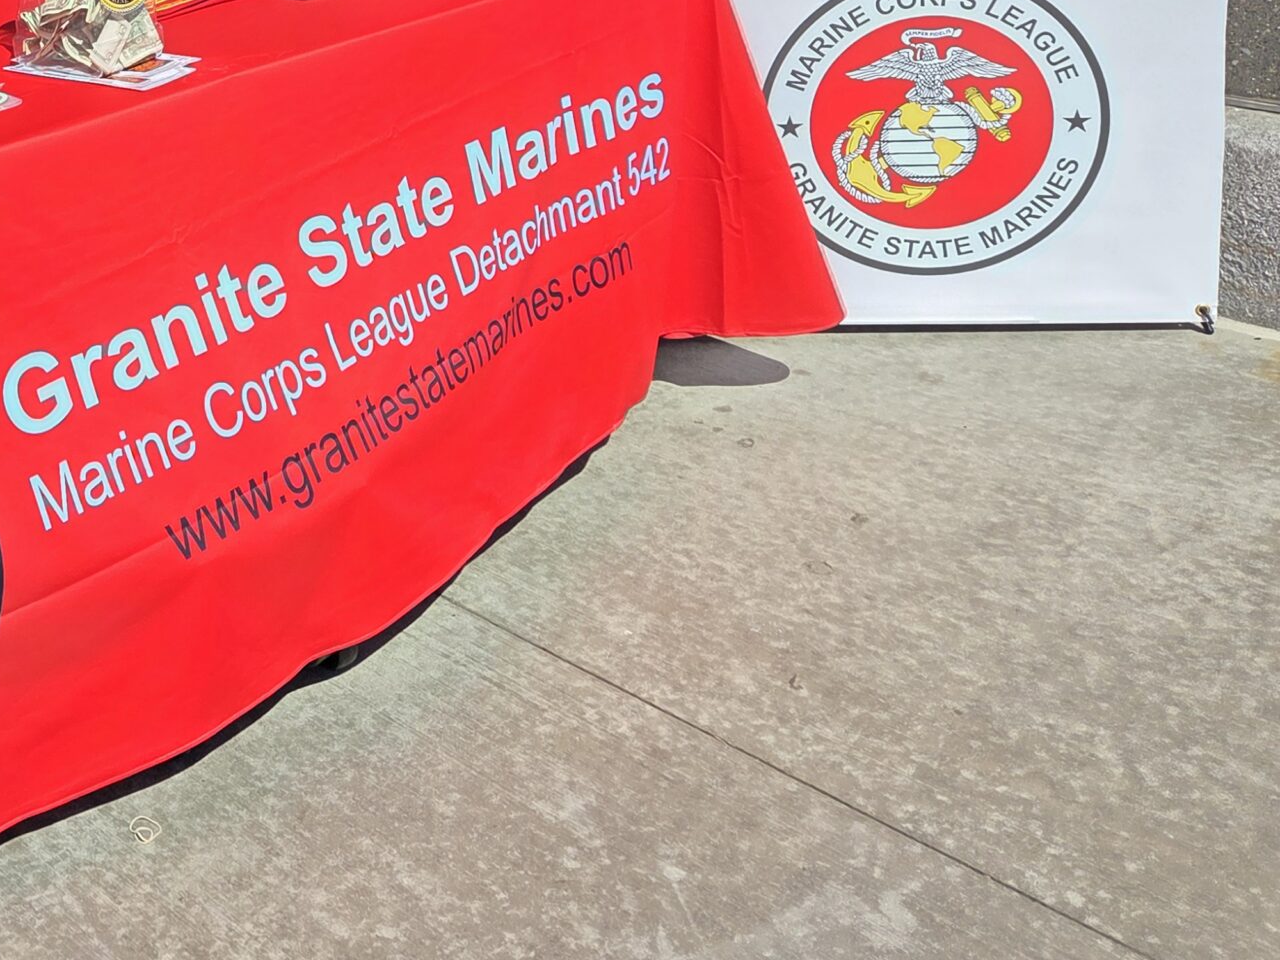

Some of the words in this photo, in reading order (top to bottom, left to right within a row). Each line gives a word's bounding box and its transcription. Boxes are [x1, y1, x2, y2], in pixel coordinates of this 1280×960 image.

[785, 5, 871, 92] MARINE
[789, 163, 879, 249] GRANITE
[883, 235, 974, 259] STATE
[978, 156, 1080, 249] MARINES
[2, 260, 287, 435] Granite
[298, 175, 455, 288] State
[464, 72, 665, 206] Marines
[29, 418, 196, 531] Marine
[204, 348, 325, 437] Corps
[324, 272, 448, 372] League
[449, 166, 625, 297] Detachmant
[626, 136, 671, 197] 542
[165, 240, 634, 559] www.granitestatemarines.com
